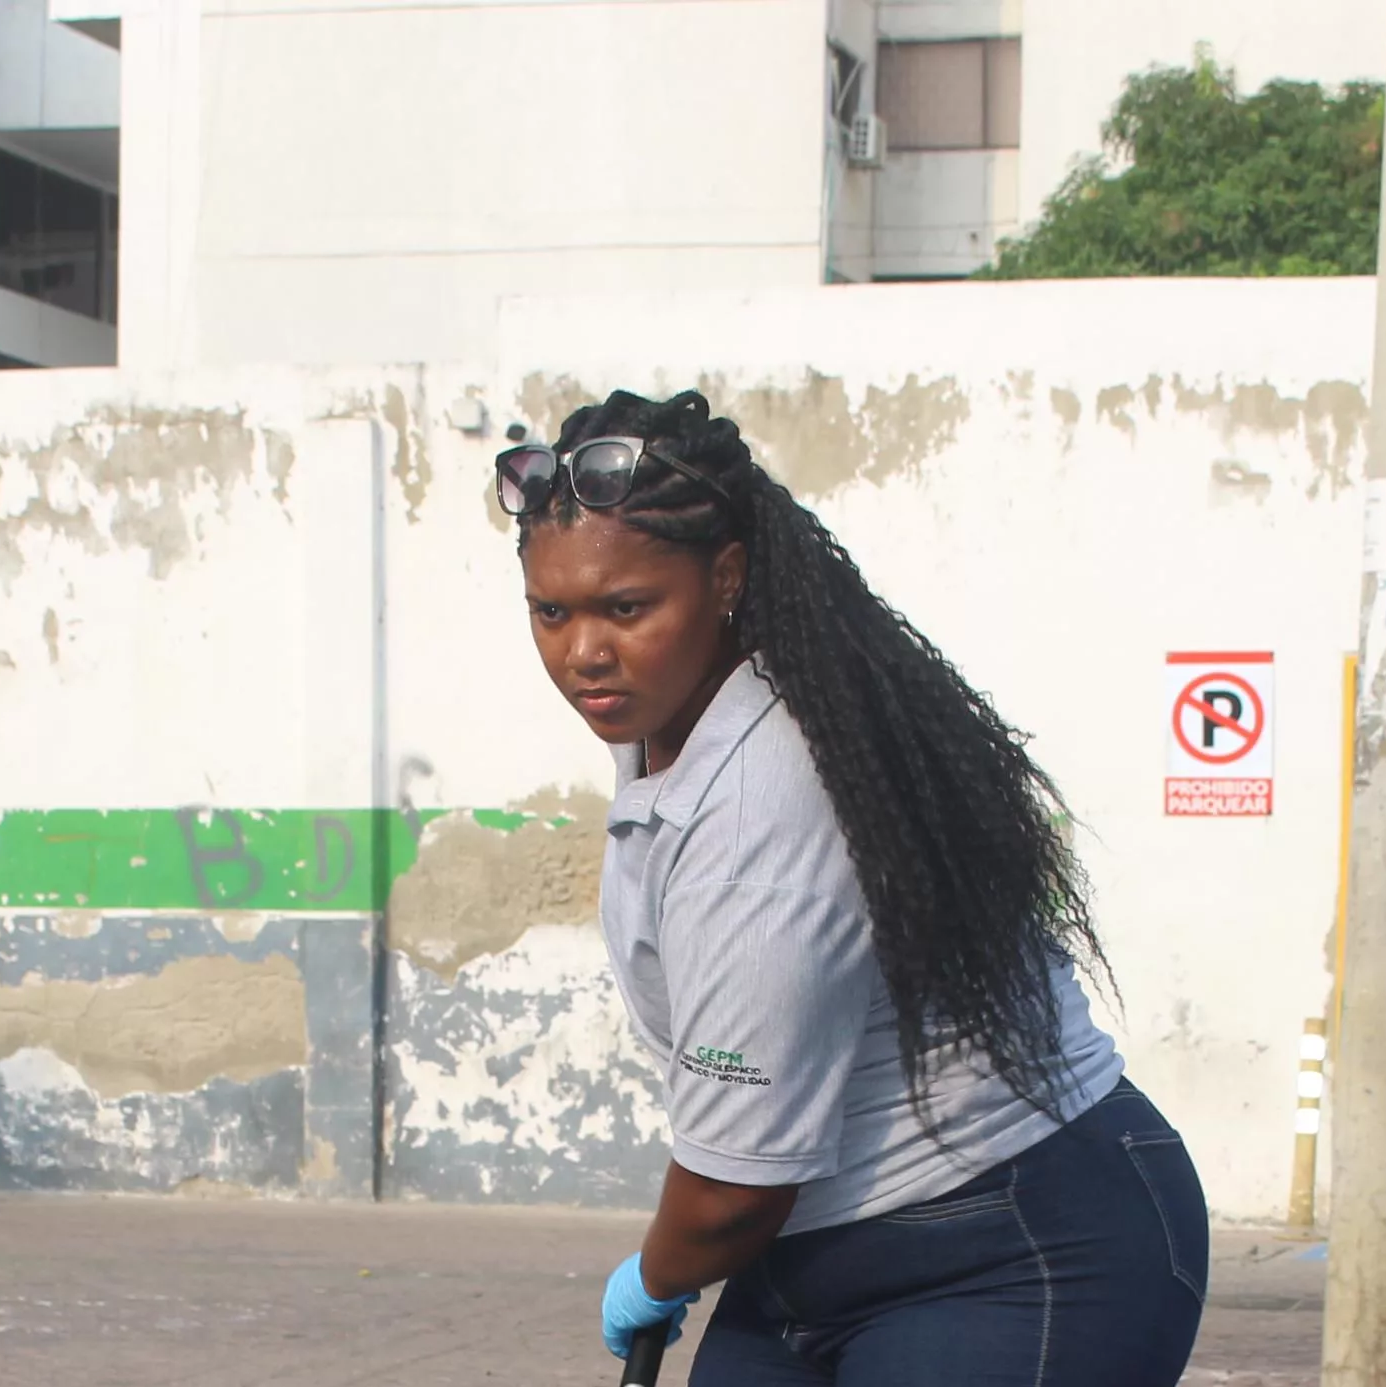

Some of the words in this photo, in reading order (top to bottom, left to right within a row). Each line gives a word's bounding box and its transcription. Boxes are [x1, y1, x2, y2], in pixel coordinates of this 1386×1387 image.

[1203, 690, 1242, 747] P
[1168, 780, 1269, 796] PROHIBIDO
[1168, 796, 1268, 814] PARQUEAR
[696, 1046, 744, 1065] GEPM
[723, 1063, 762, 1076] ESPACIO
[718, 1074, 772, 1086] MOVILIDAD
